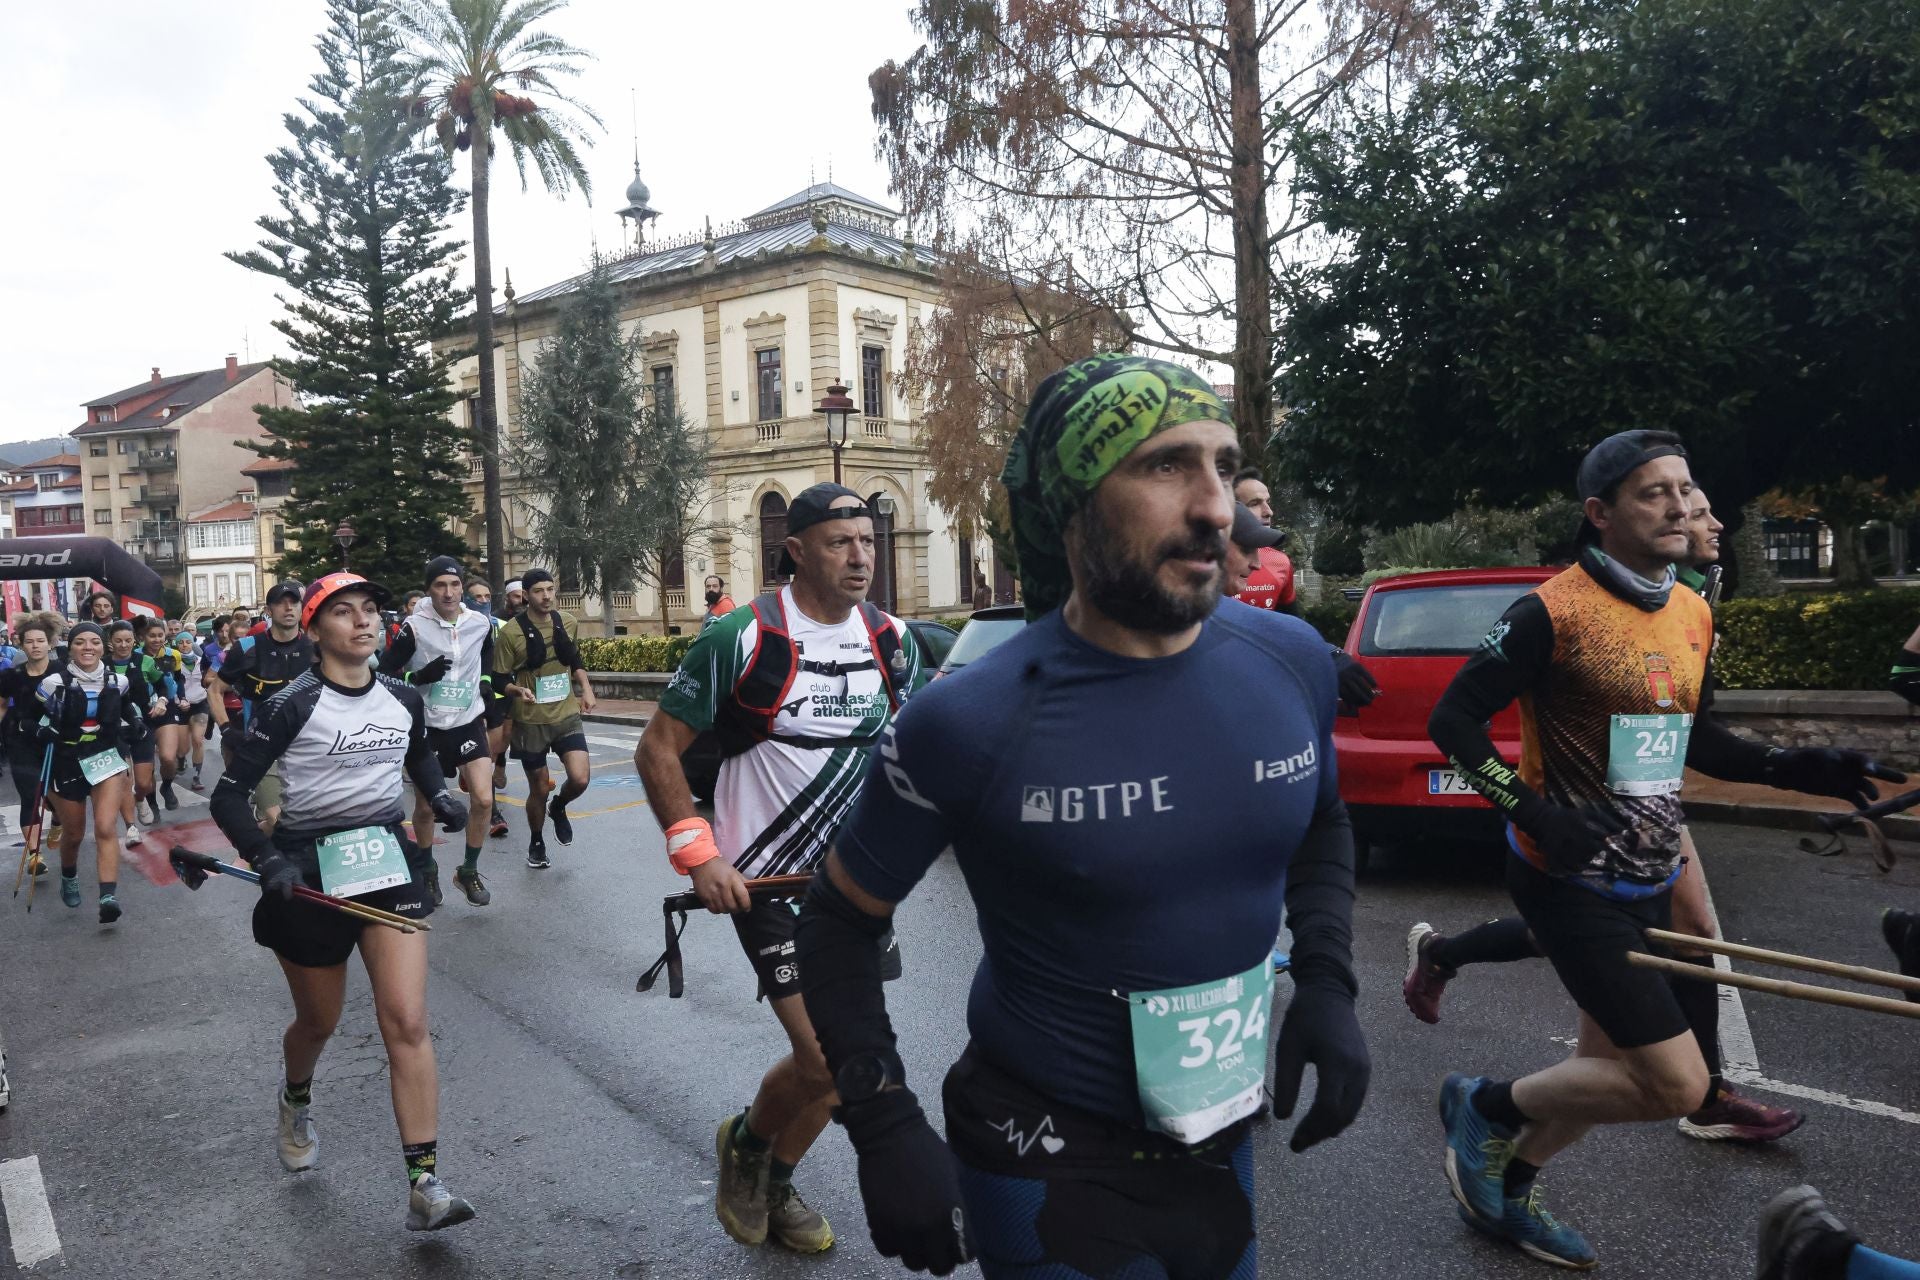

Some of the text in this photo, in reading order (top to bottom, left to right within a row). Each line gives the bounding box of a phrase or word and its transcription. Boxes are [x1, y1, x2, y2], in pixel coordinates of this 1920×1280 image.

[440, 686, 465, 699] 337
[543, 679, 563, 691] 342
[810, 683, 831, 693] club
[813, 705, 883, 718] atletismo
[327, 730, 406, 756] Llosorio
[1635, 731, 1678, 757] 241
[89, 755, 112, 772] 309
[881, 707, 941, 814] nd
[1255, 741, 1316, 783] land
[1477, 756, 1515, 786] TRAIL
[1443, 773, 1477, 791] 73
[1060, 776, 1174, 822] GTPE
[339, 838, 385, 866] 319
[351, 860, 380, 870] LORENA
[395, 902, 422, 912] land
[1178, 994, 1266, 1069] 324
